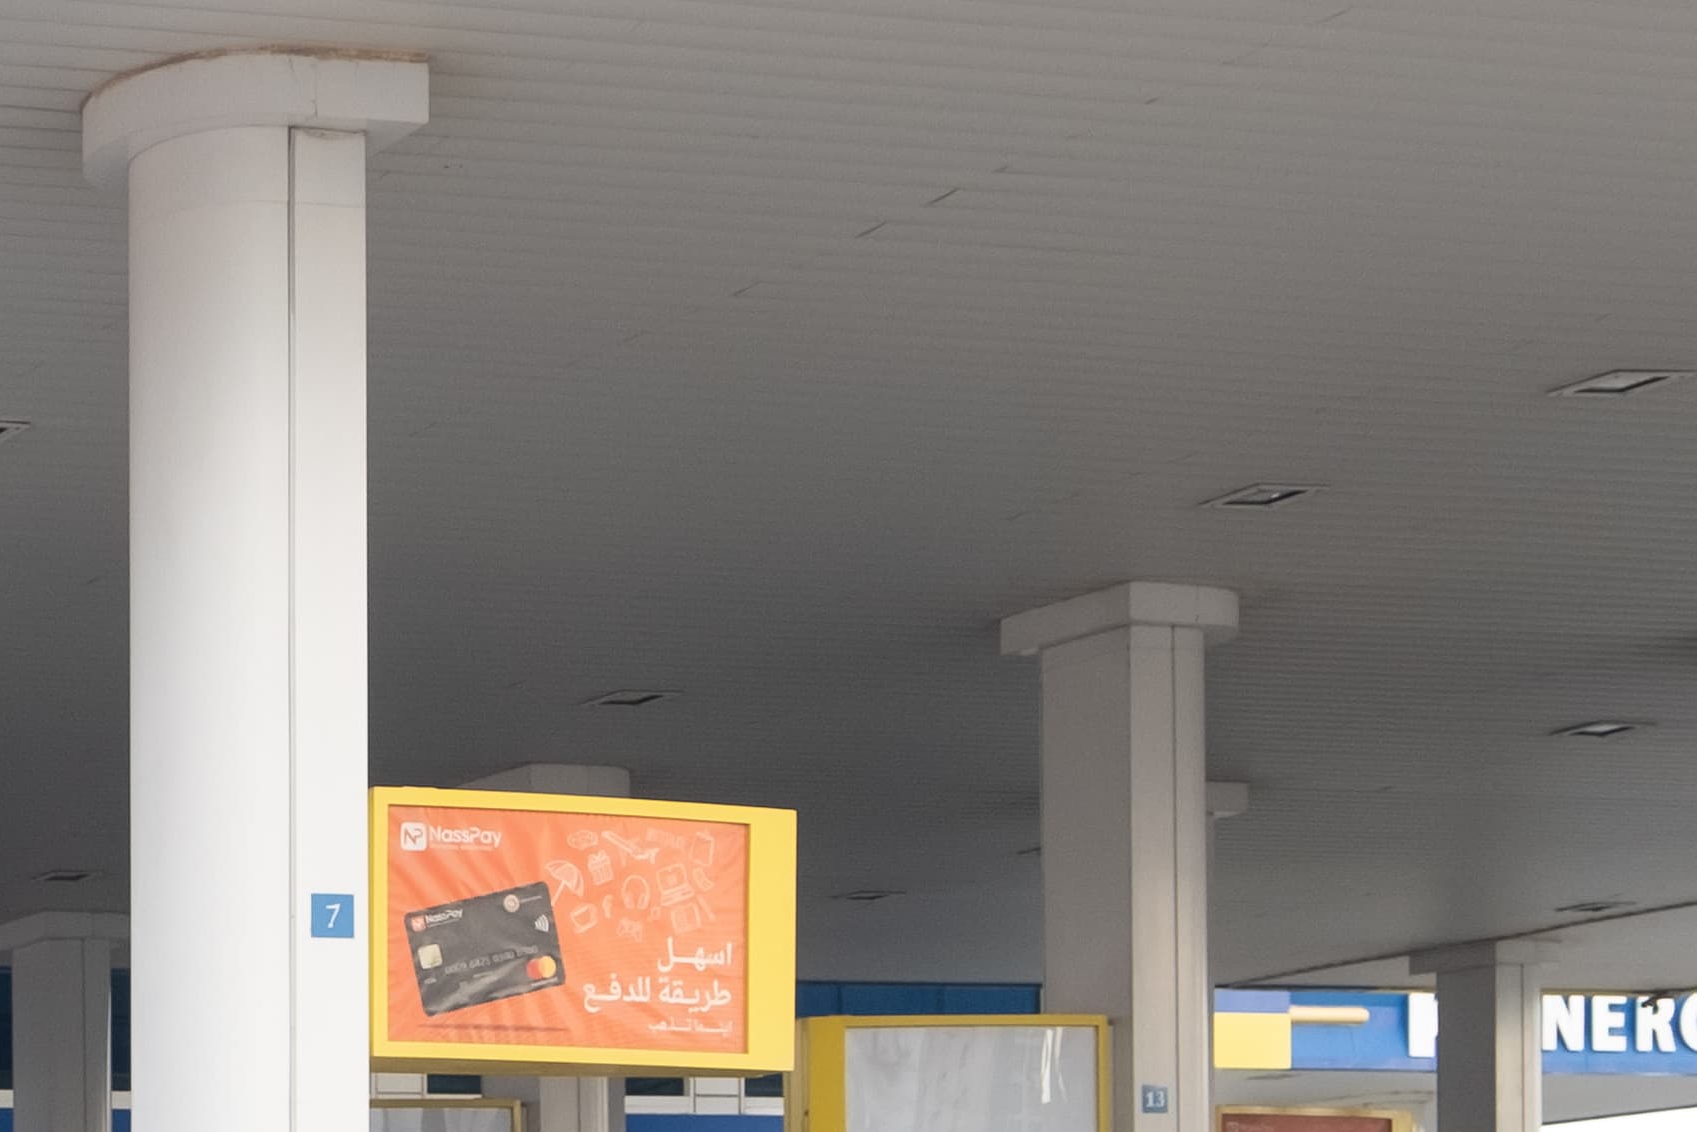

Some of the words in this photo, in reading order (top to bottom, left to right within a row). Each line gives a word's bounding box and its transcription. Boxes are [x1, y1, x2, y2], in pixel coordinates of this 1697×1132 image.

[430, 826, 502, 848] NassPay
[325, 903, 341, 929] 7
[582, 973, 651, 1013] للدفع
[658, 975, 732, 1013] طريقة
[1542, 994, 1697, 1052] NER
[1145, 1091, 1165, 1108] 13
